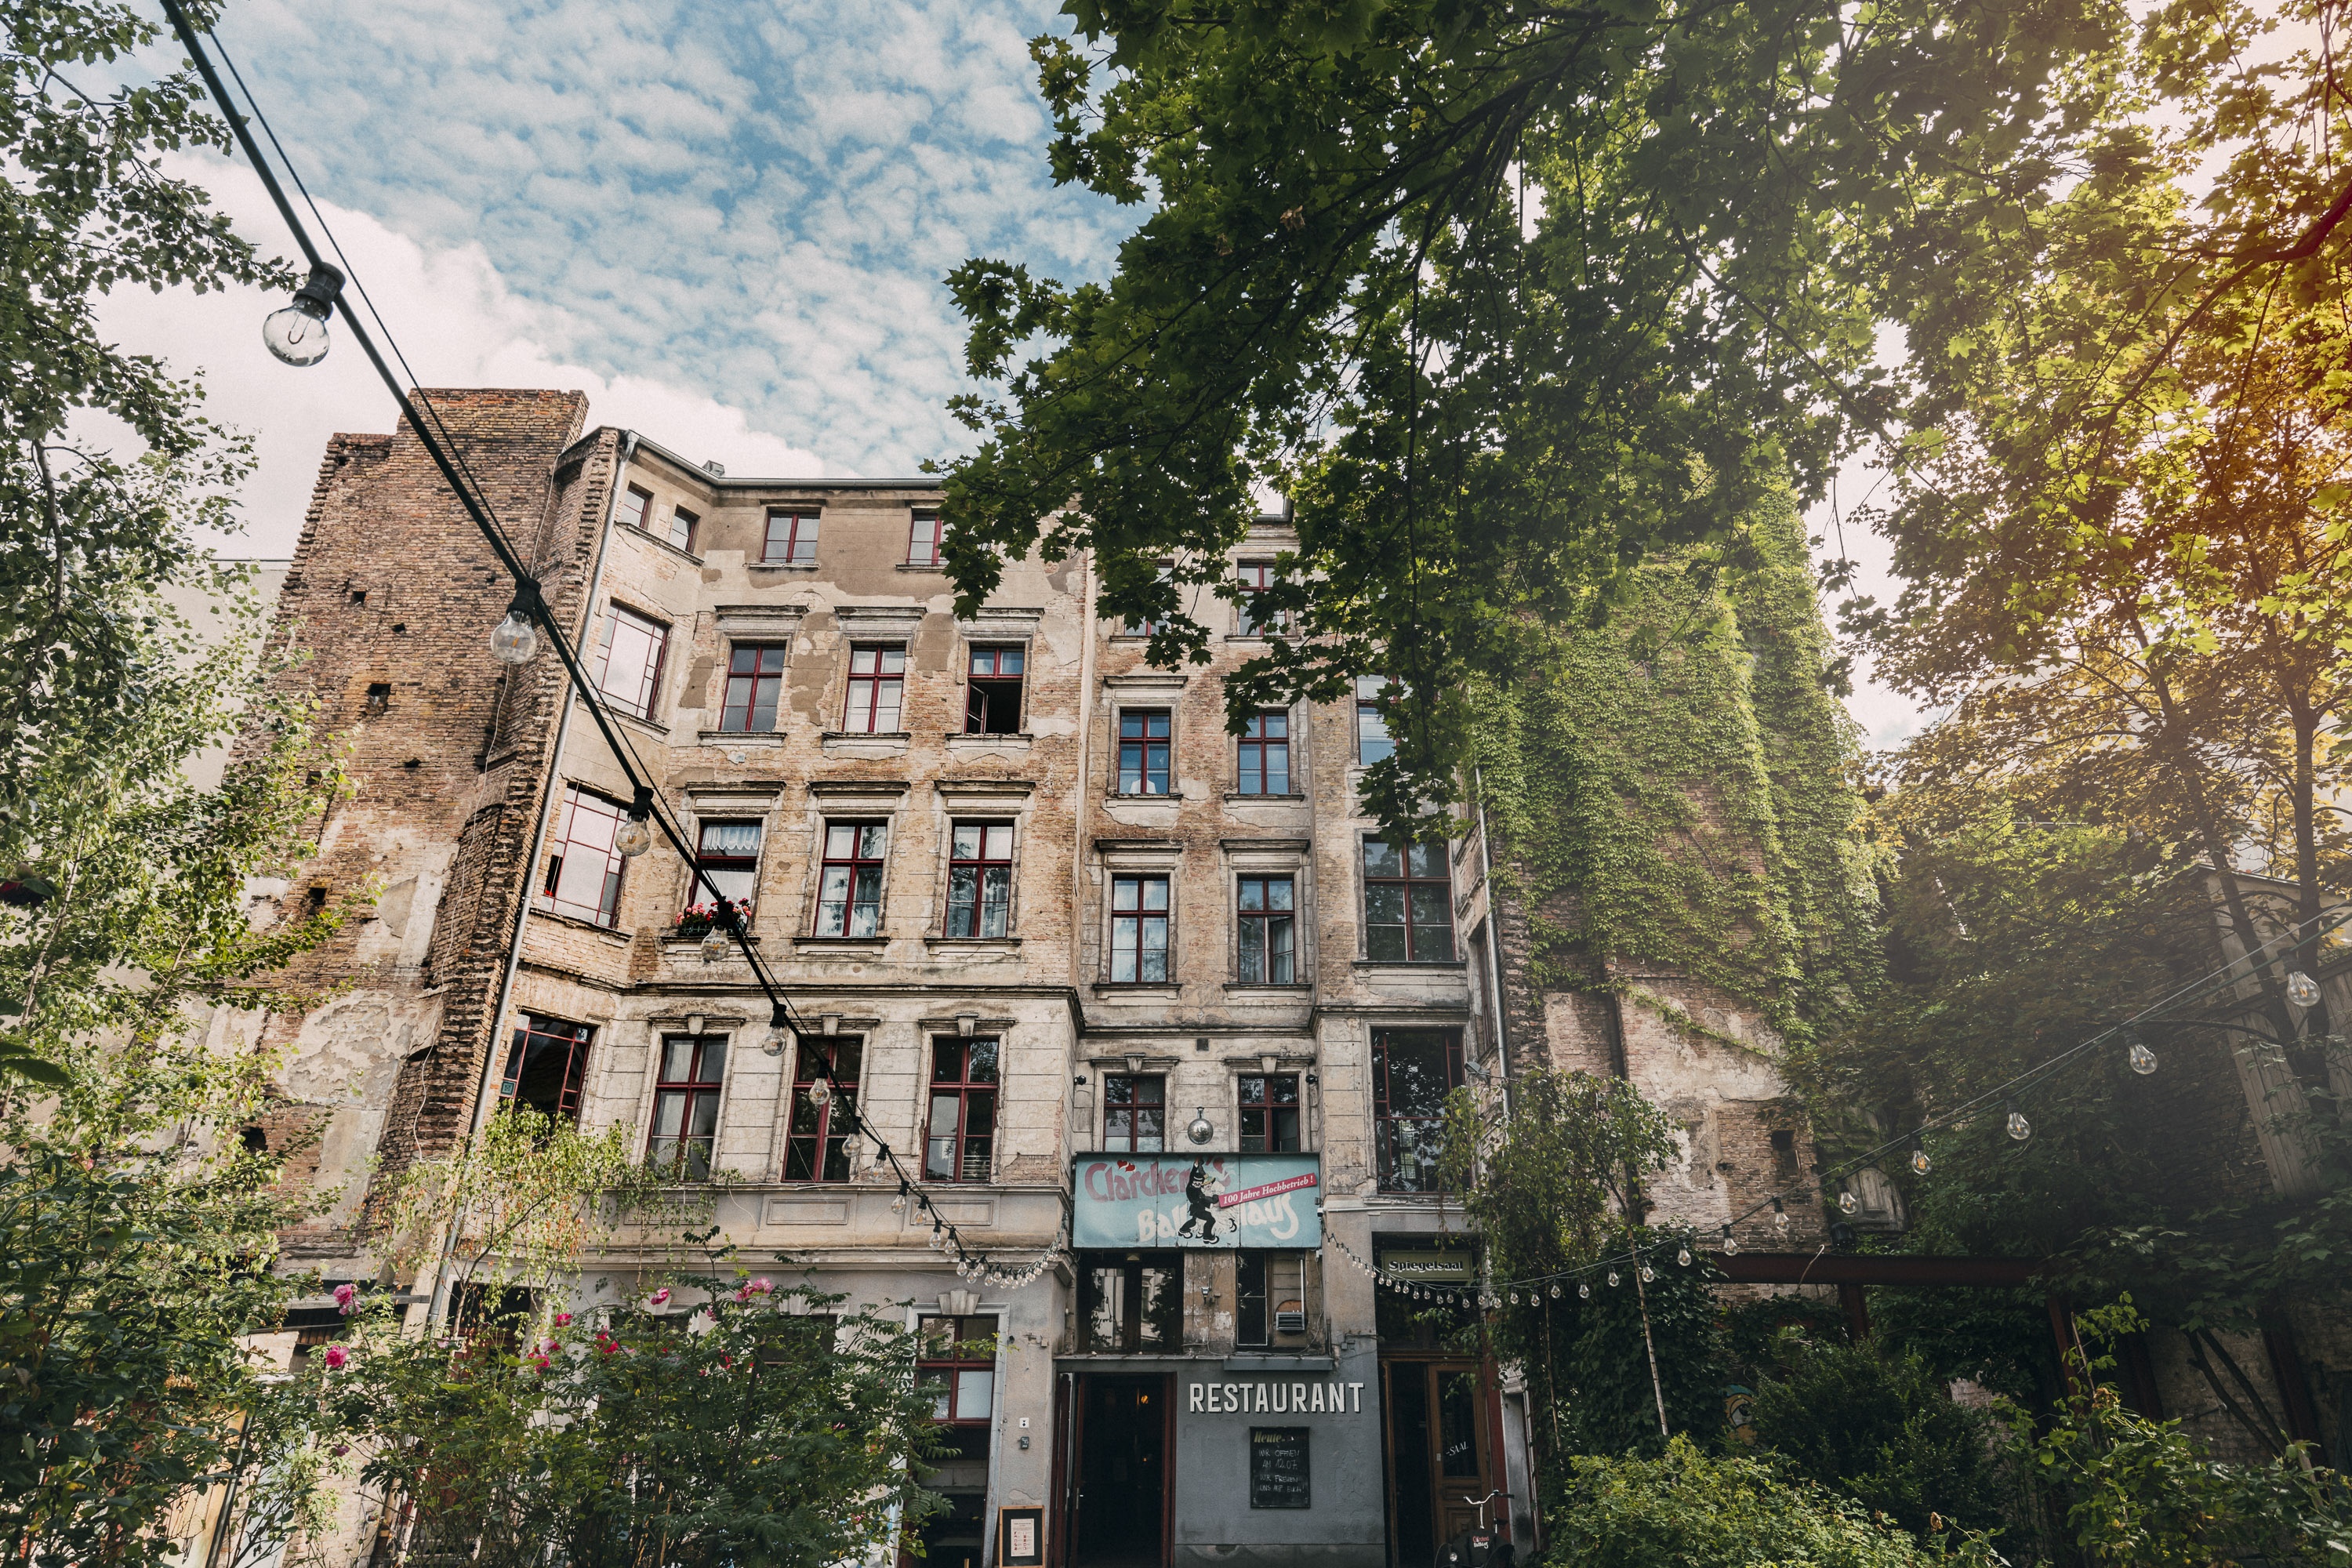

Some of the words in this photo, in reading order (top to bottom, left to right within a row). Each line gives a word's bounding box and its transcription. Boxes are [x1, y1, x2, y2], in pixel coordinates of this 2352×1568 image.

[1223, 1193, 1238, 1204] 100
[1239, 1189, 1260, 1202] Jahre
[1261, 1177, 1308, 1195] Hochbetrieb
[1388, 1260, 1463, 1273] Spiegelsaal
[1189, 1382, 1364, 1414] RESTAURANT
[1258, 1449, 1271, 1457] WIR
